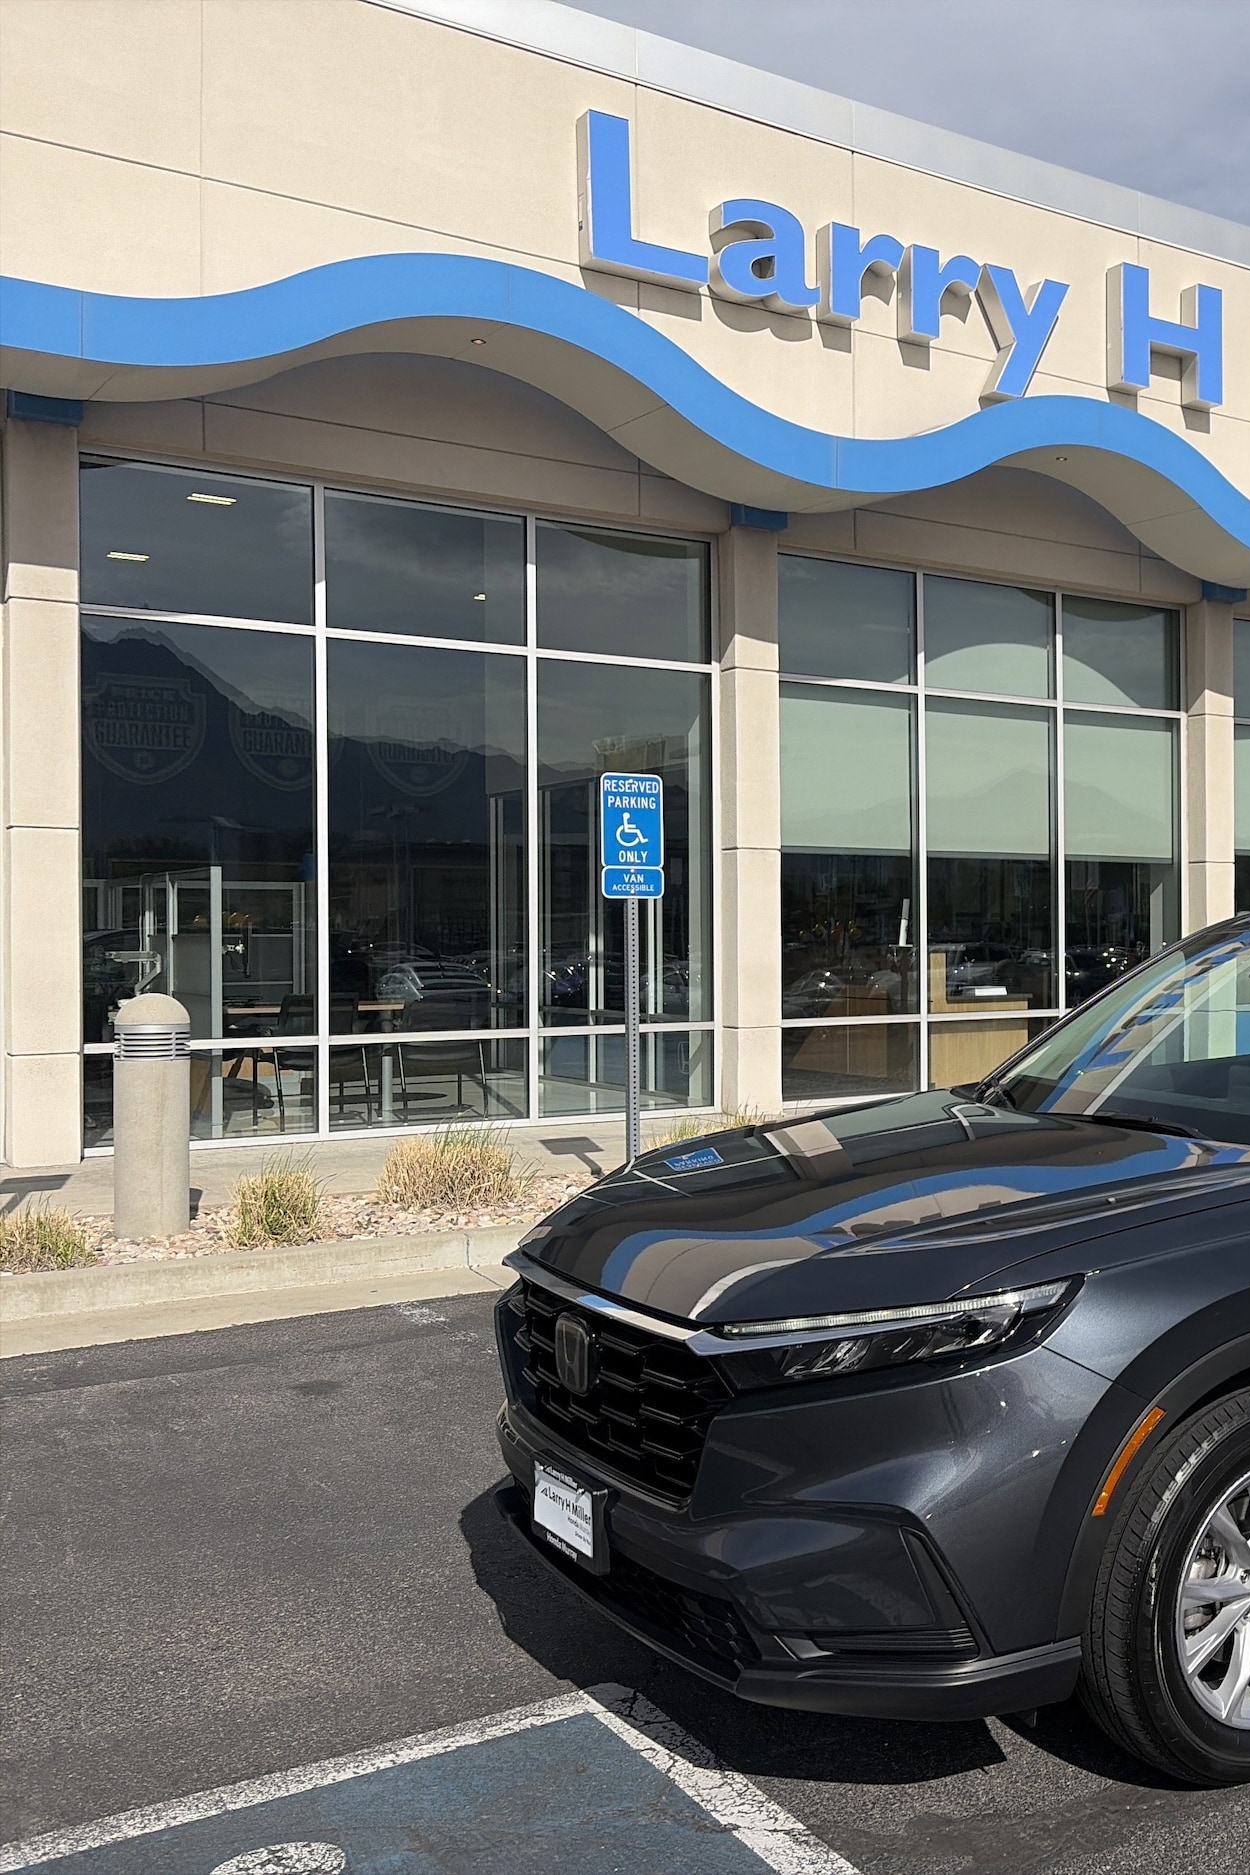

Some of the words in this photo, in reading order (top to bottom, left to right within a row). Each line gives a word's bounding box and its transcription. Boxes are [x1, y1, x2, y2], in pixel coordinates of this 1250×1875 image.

[579, 109, 1070, 402] Larry
[1108, 262, 1222, 407] H
[94, 721, 191, 749] GUARANTEE
[604, 780, 659, 793] RESERVED
[607, 795, 656, 809] PARKING
[618, 850, 648, 863] ONLY
[623, 873, 644, 883] VAN
[612, 884, 655, 892] ACCESSIBLE
[549, 1486, 565, 1511] Larry
[566, 1498, 571, 1513] H
[572, 1502, 591, 1527] Miller
